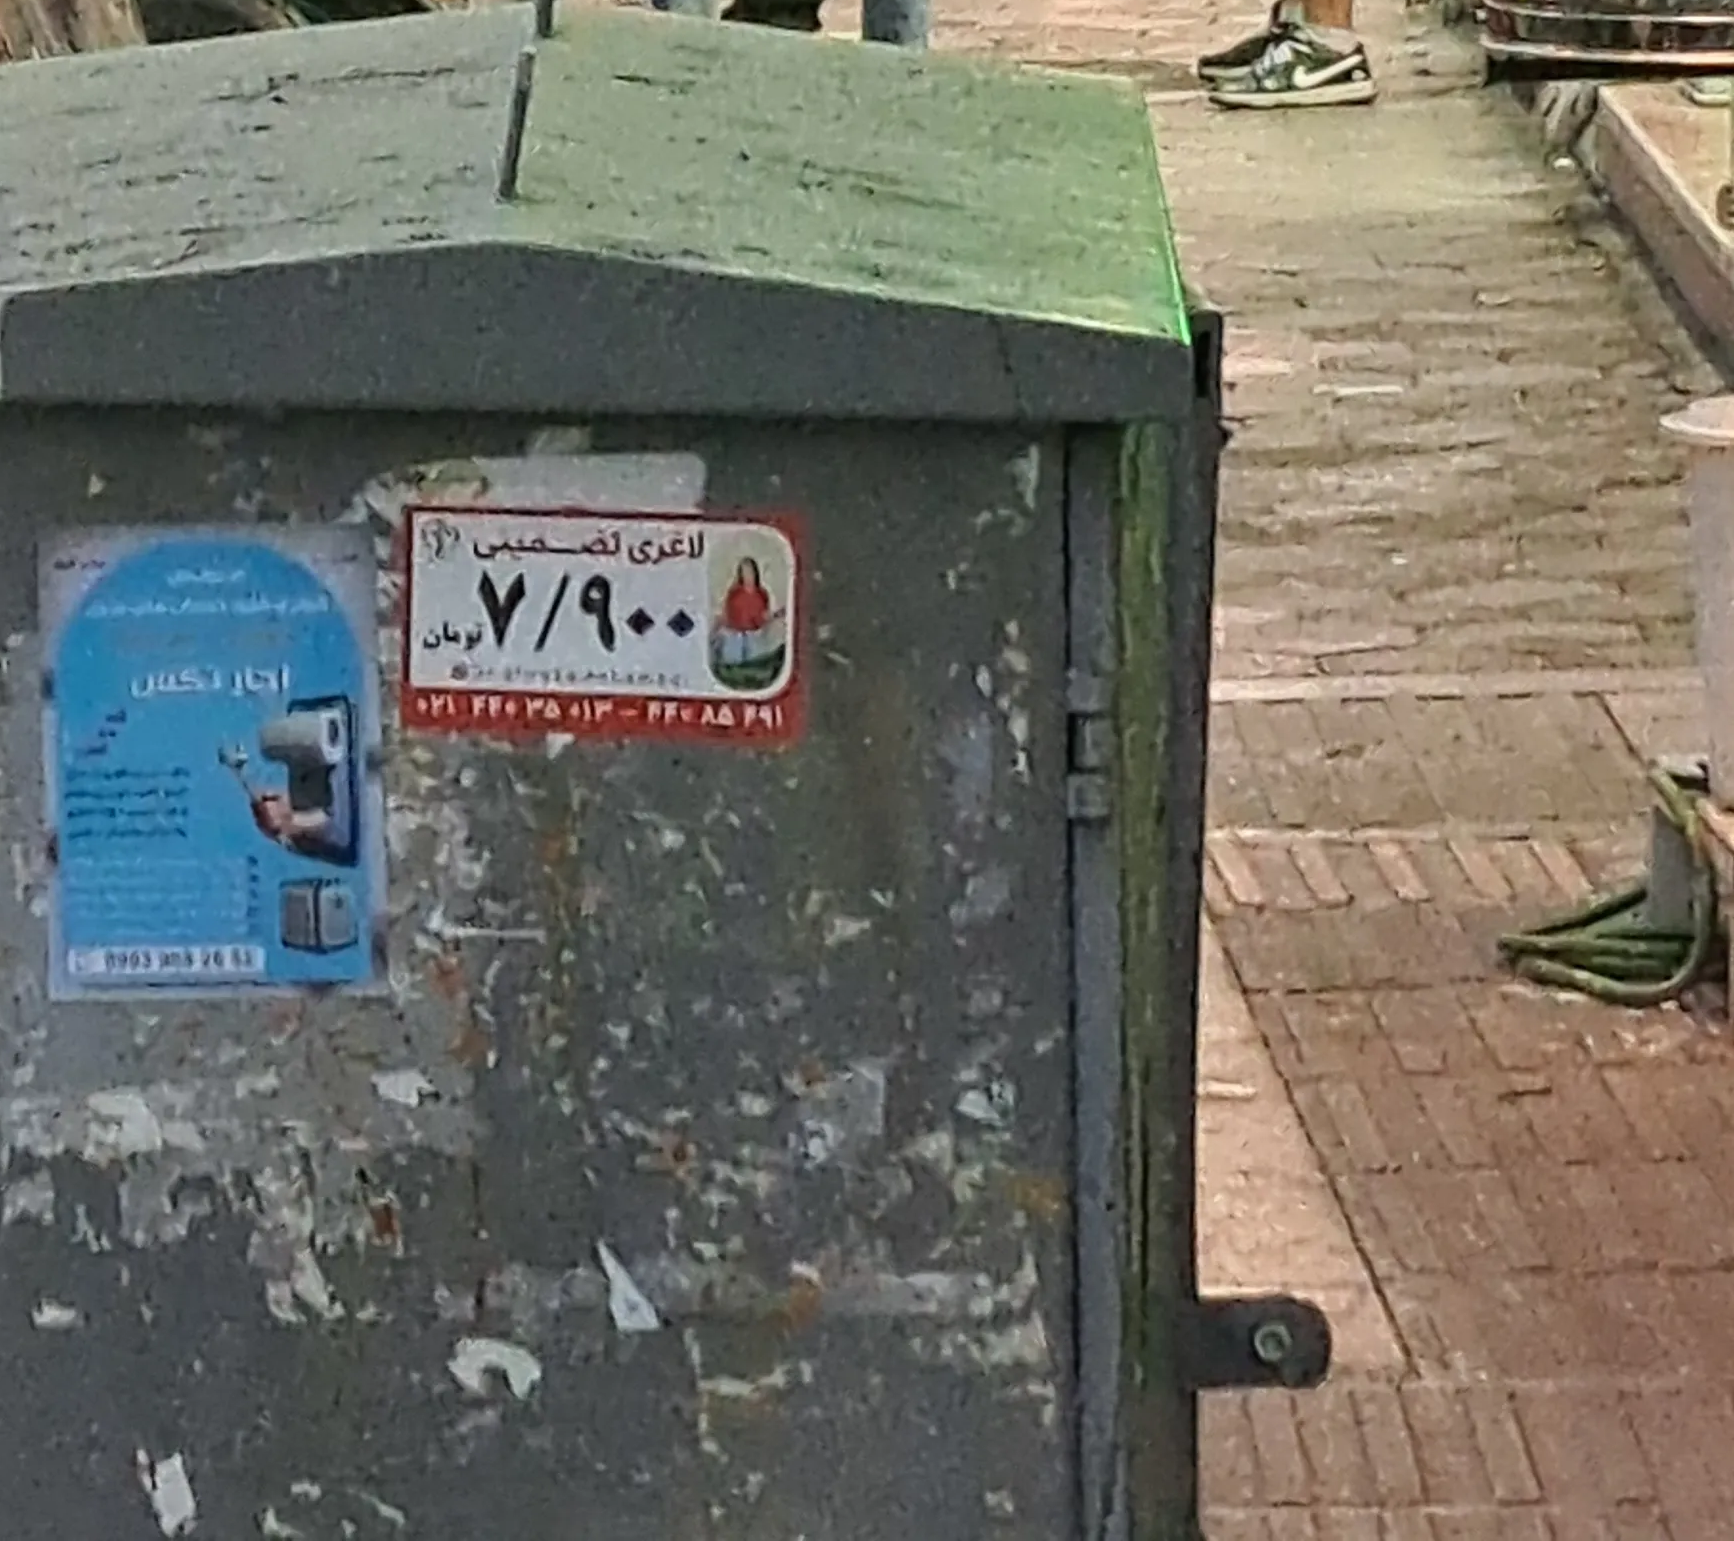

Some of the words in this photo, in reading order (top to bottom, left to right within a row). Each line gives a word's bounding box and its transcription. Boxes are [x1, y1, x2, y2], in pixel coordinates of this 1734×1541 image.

[627, 530, 705, 565] لاغری
[421, 621, 485, 653] تومان
[476, 570, 696, 654] ۷/۹۰۰
